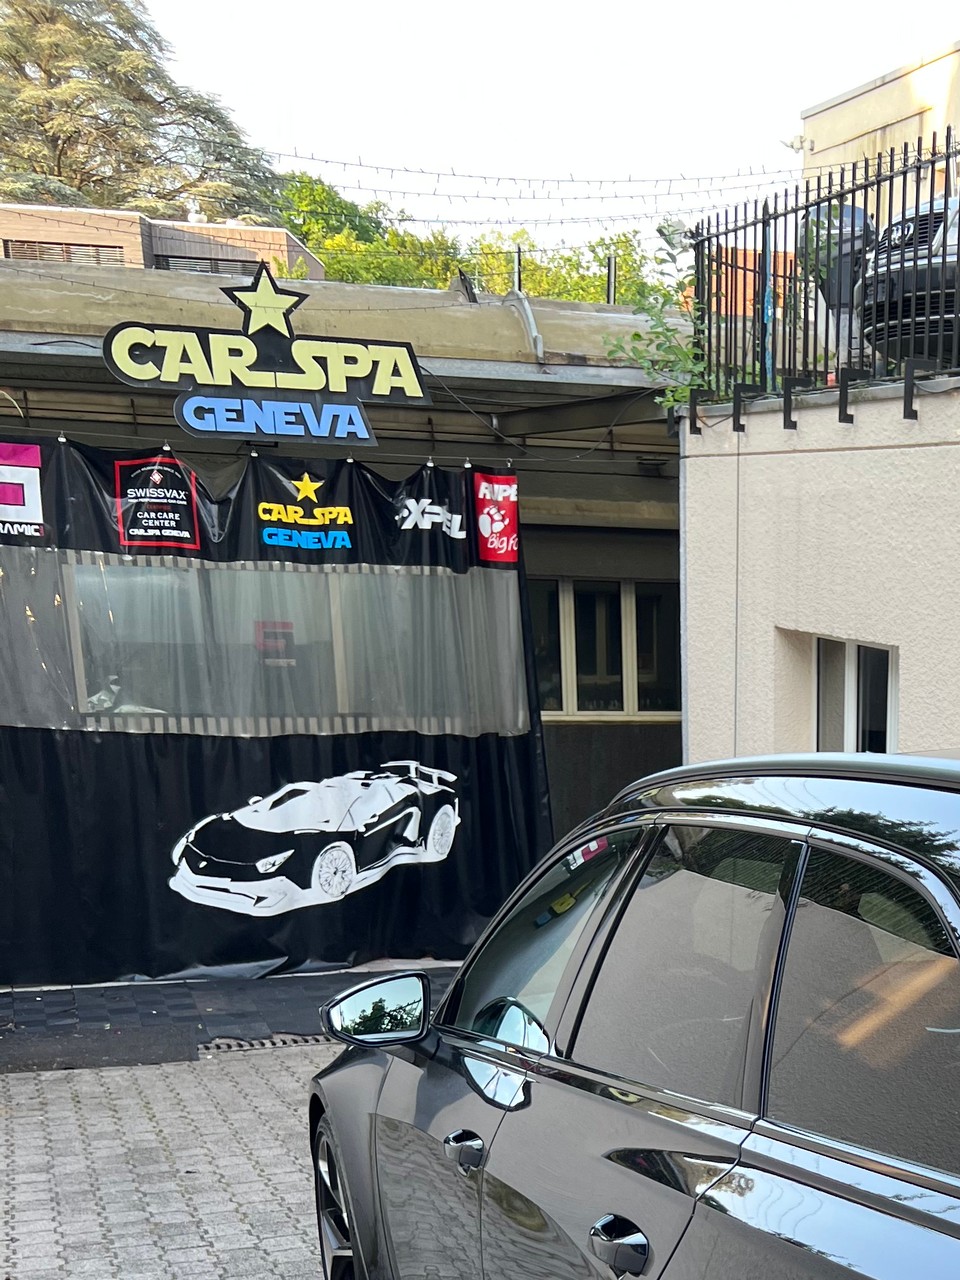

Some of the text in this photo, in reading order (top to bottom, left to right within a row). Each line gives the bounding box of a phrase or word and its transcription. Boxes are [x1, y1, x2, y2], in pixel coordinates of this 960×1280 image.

[111, 326, 424, 397] CAR SPA
[182, 396, 370, 439] GENEVA
[127, 488, 187, 500] SWISSVAX
[137, 511, 180, 520] CAR CARE
[258, 502, 353, 525] CAR SPA
[400, 499, 466, 539] XPEL
[262, 527, 352, 549] GENEVA
